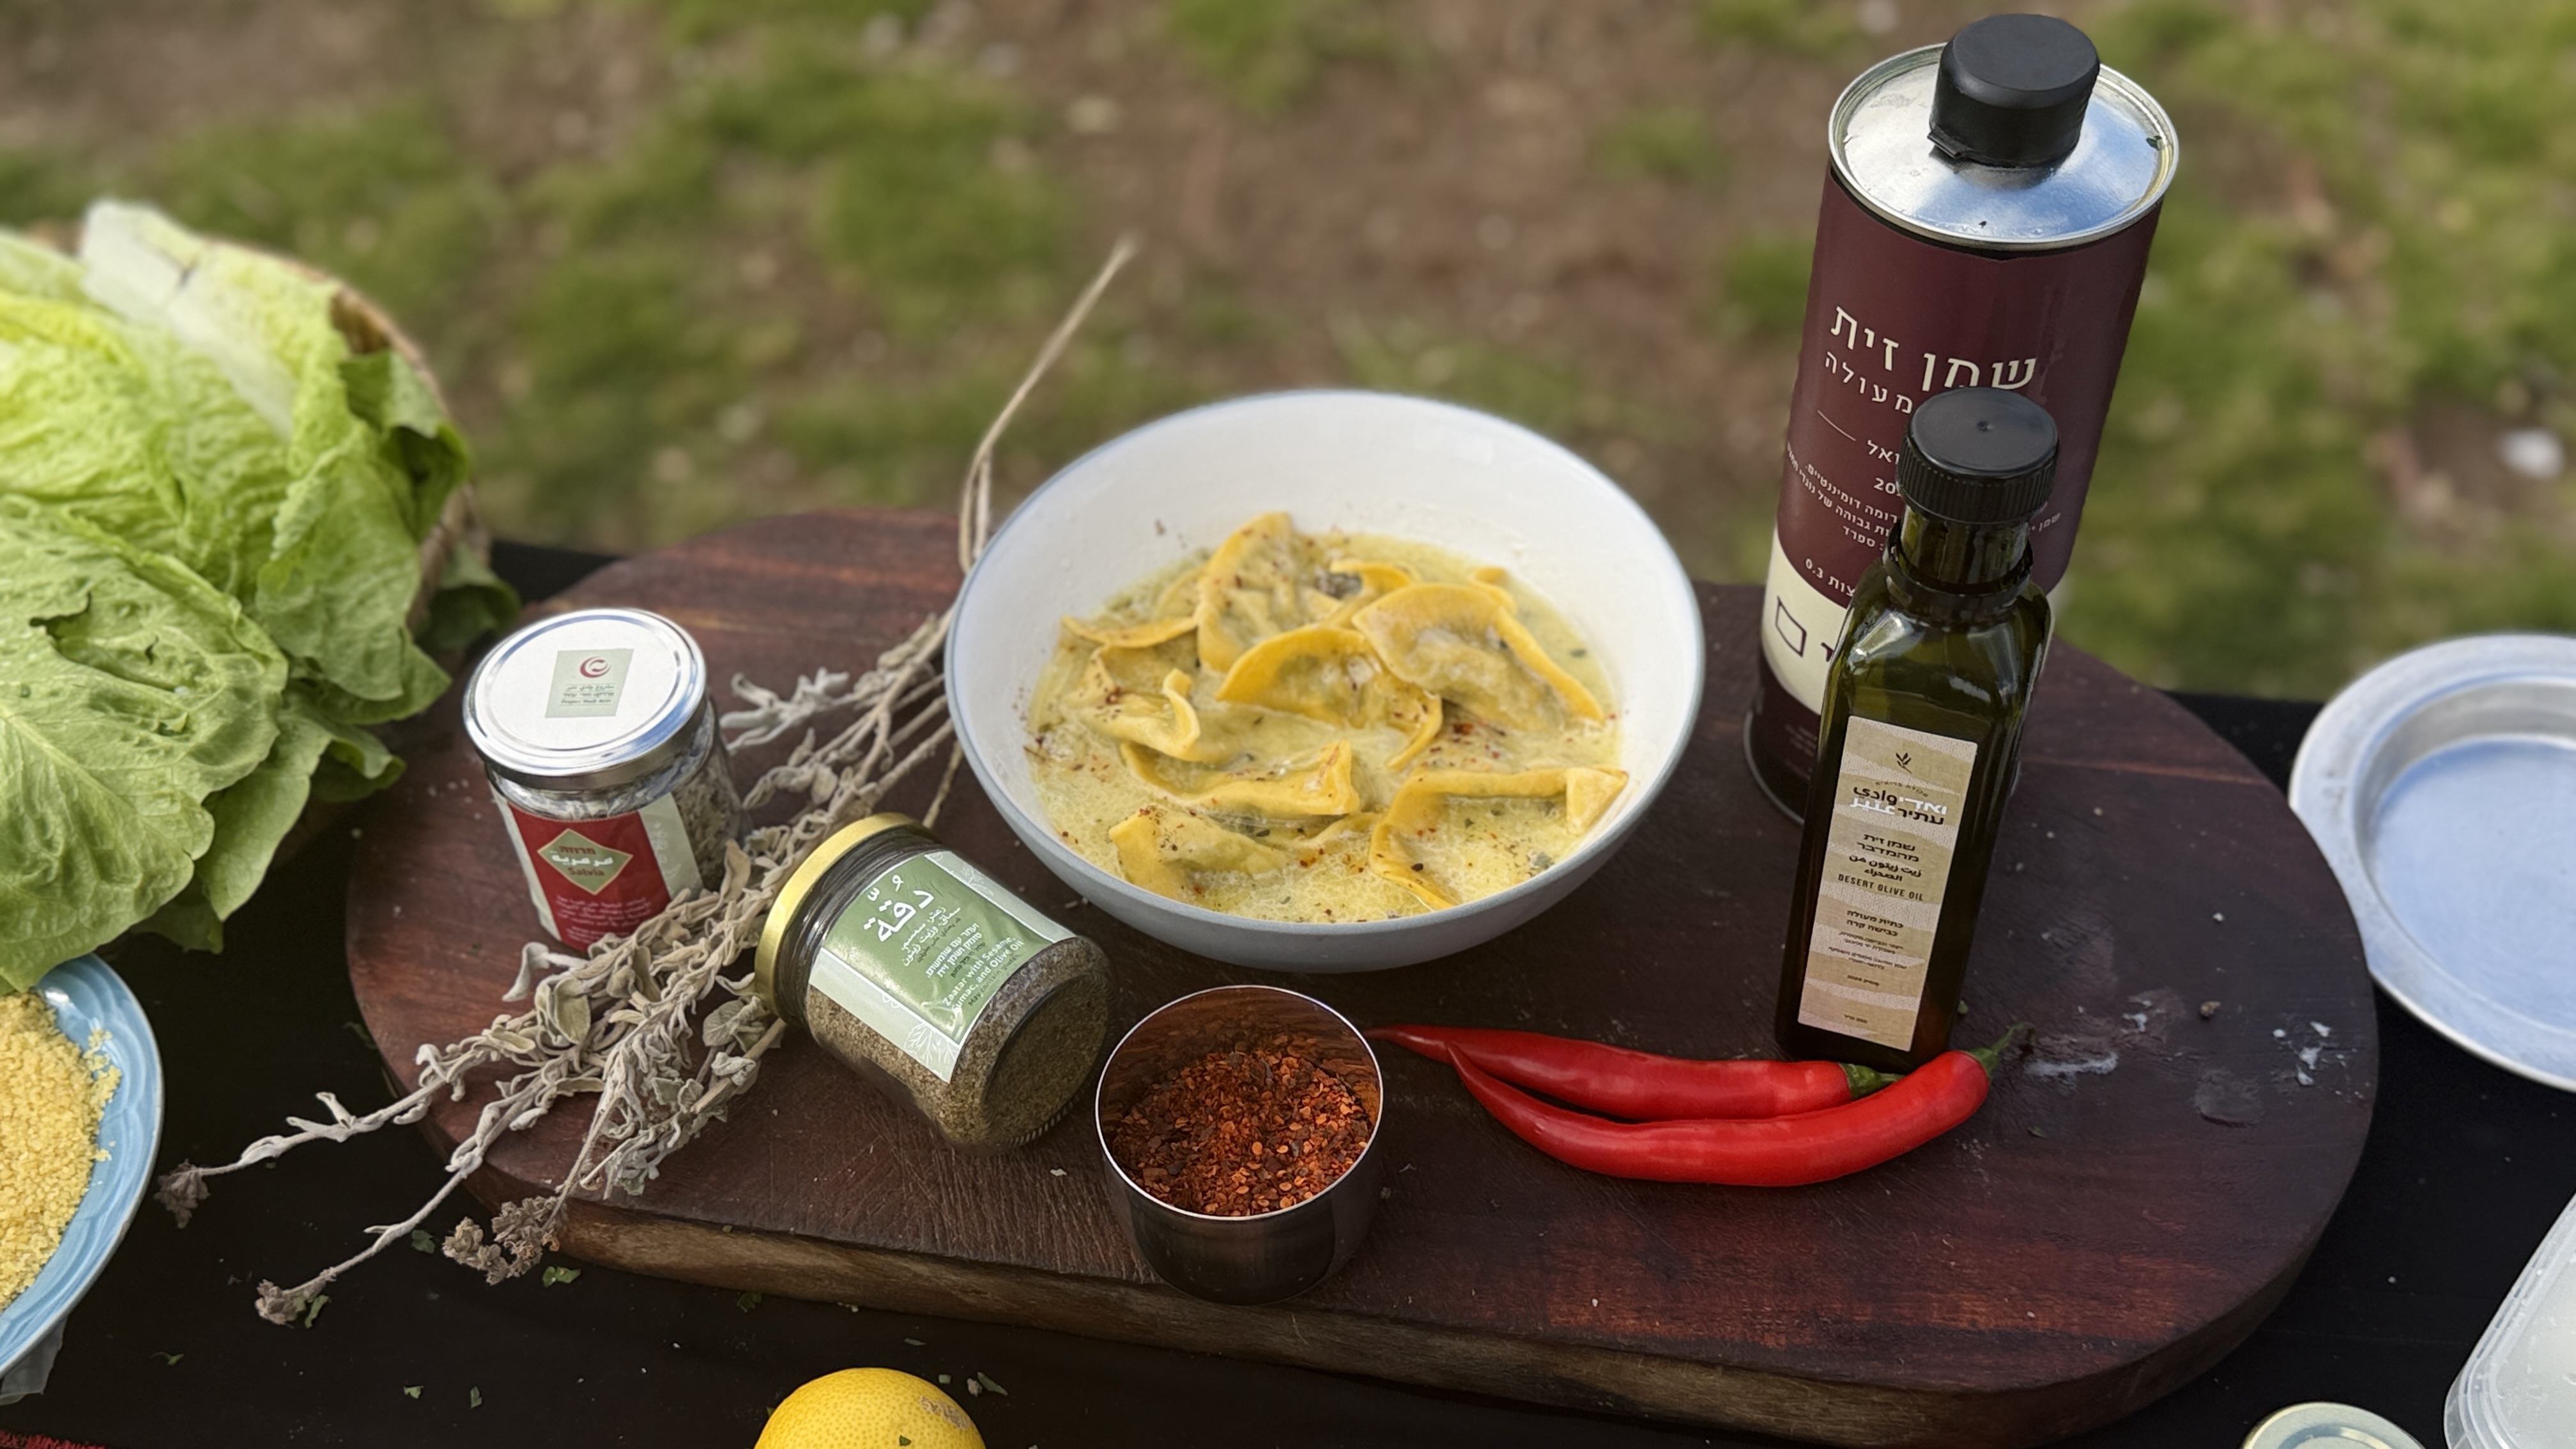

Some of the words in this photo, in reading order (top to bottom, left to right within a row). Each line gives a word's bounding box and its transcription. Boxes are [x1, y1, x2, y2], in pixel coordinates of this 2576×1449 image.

[1830, 305, 1899, 372] זית
[1922, 352, 2037, 392] שמן
[1825, 351, 1913, 415] מעולה
[1867, 440, 1900, 465] ואל
[1873, 477, 1901, 497] 20
[1818, 489, 1833, 508] של
[1835, 505, 1871, 531] גבוהה
[1864, 505, 1898, 524] רומה
[1843, 525, 1876, 548] ספרד
[1805, 558, 1824, 579] 0.3
[1828, 576, 1856, 597] צות
[1853, 786, 1897, 806] وادي
[1899, 796, 1947, 815] ואדי
[1897, 808, 1944, 825] עתיר
[1863, 834, 1885, 845] זית
[1887, 839, 1915, 852] שמן
[1857, 841, 1919, 862] מהמדבר
[567, 866, 605, 877] Salvia
[1837, 873, 1874, 889] DESERT
[1878, 884, 1905, 897] OLIVE
[1908, 891, 1924, 901] OIL
[1846, 910, 1877, 922] מעולה
[950, 937, 962, 947] עם
[976, 966, 992, 983] and
[990, 948, 1011, 967] Olive
[1010, 939, 1025, 951] Oil
[942, 977, 967, 1006] Zaatar
[966, 959, 984, 978] with
[982, 937, 1016, 961] Sesame,
[968, 992, 981, 1006] May
